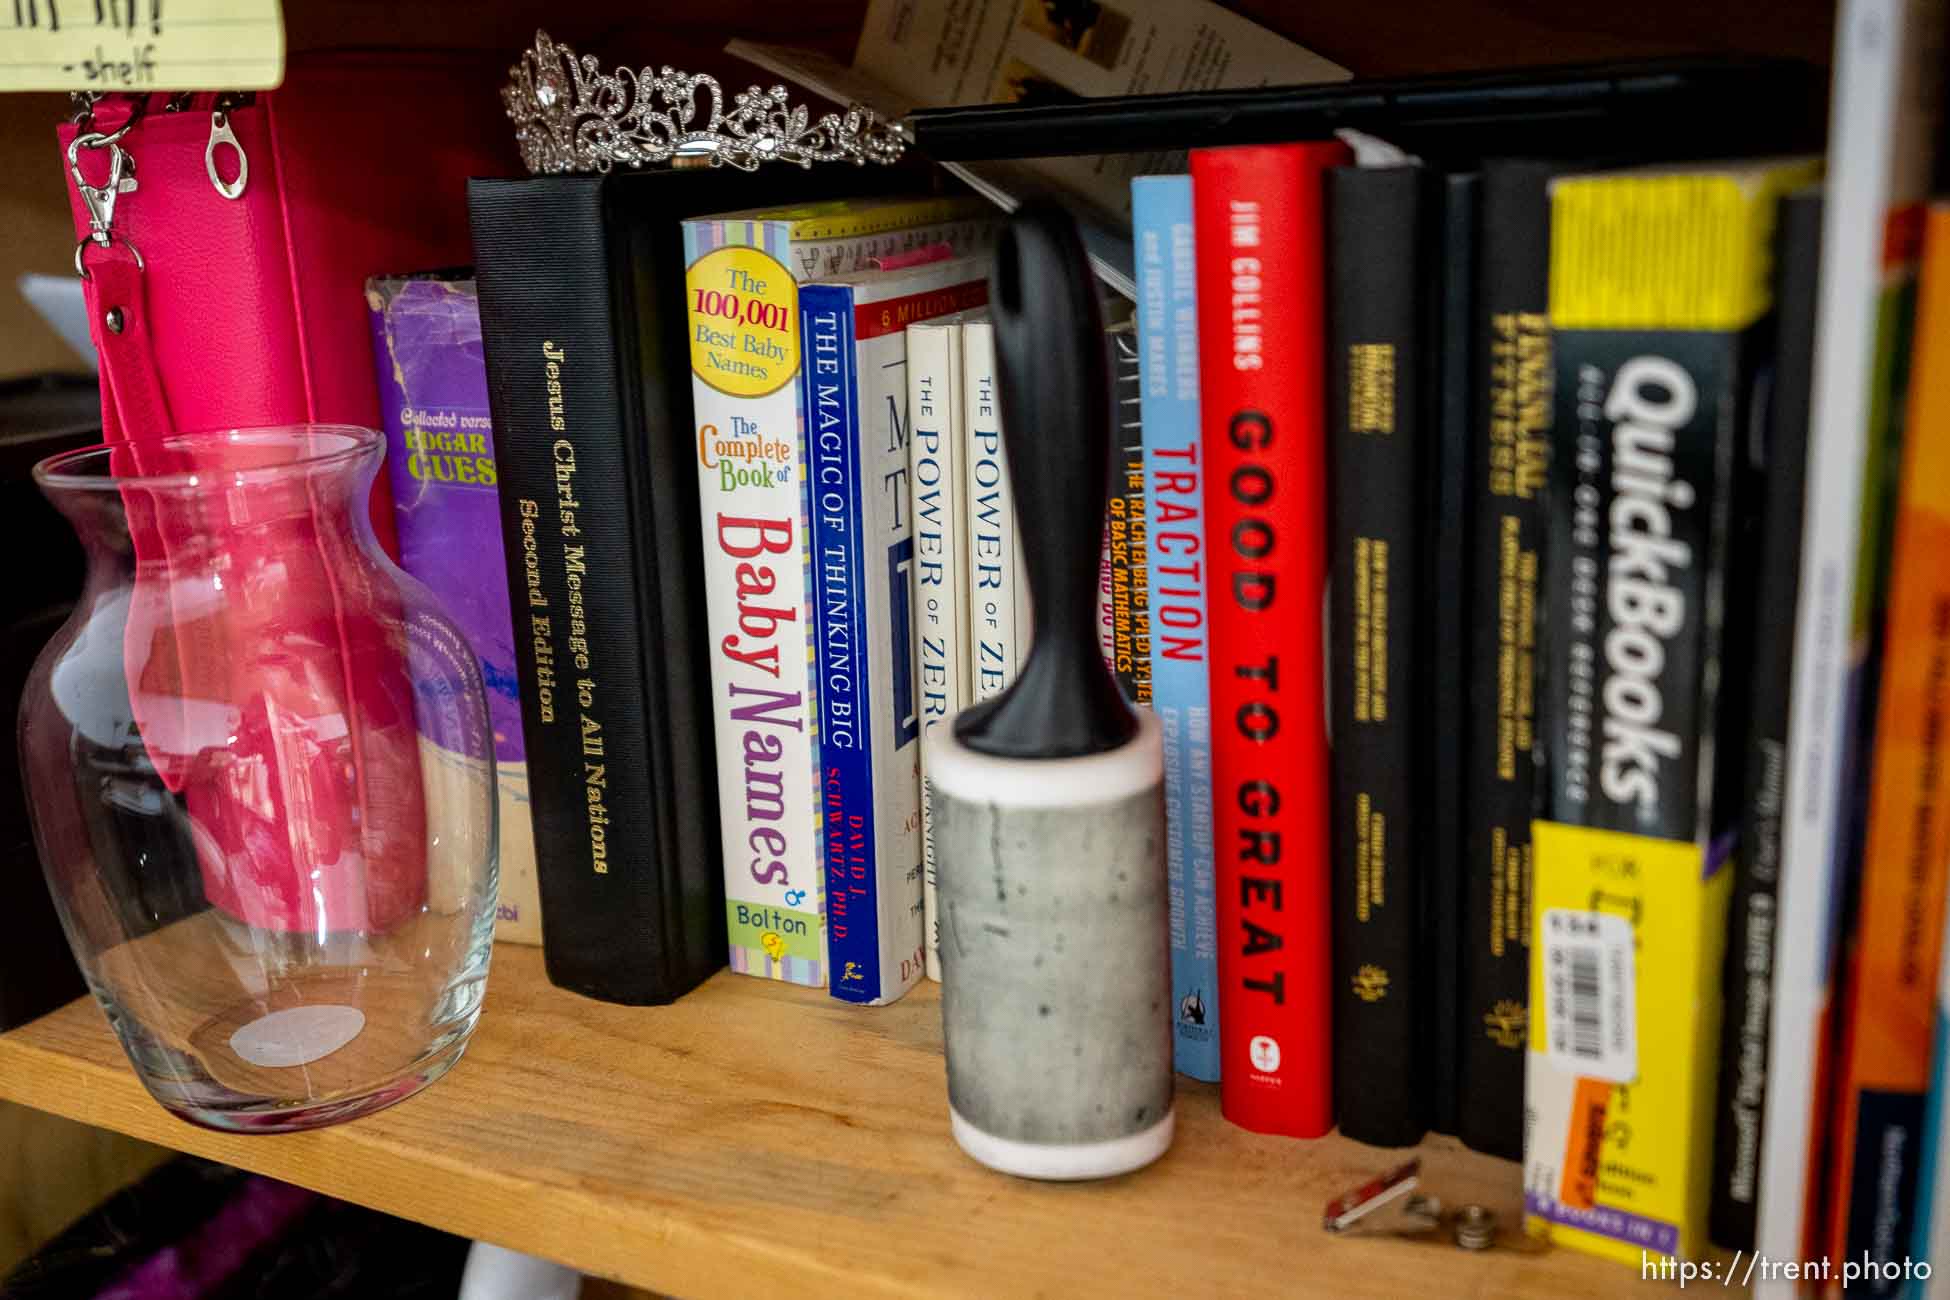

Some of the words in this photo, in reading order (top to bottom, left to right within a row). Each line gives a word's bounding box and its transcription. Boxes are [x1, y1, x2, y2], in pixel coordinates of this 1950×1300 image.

[1229, 199, 1262, 248] JIM
[725, 267, 768, 296] The
[692, 288, 790, 333] 100,001
[881, 310, 891, 327] 6
[1231, 257, 1264, 372] COLLINS
[695, 323, 737, 350] Best
[743, 333, 790, 367] Baby
[706, 350, 769, 381] Names
[814, 311, 839, 375] THE
[542, 340, 566, 431] Jesus
[919, 375, 933, 417] THE
[978, 375, 993, 417] THE
[404, 431, 488, 454] EDGAR
[699, 424, 791, 469] Complete
[730, 415, 759, 438] The
[817, 383, 844, 486] MAGIC
[407, 453, 498, 486] GUES
[553, 439, 581, 537] Christ
[718, 458, 775, 492] Book
[776, 464, 792, 483] of
[822, 492, 845, 532] OF
[916, 429, 944, 586] POWER
[974, 429, 1002, 590] POWER
[1109, 497, 1125, 520] OF
[1228, 410, 1277, 612] GOOD
[519, 498, 549, 609] Second
[1111, 520, 1128, 566] BASIC
[1152, 441, 1204, 662] TRACTION
[563, 543, 590, 671] Message
[717, 512, 797, 679] Baby
[926, 598, 939, 625] OF
[983, 601, 998, 629] OF
[1600, 355, 1700, 824] QuickBooks
[824, 544, 851, 693] THINKING
[1113, 567, 1133, 674] MATHEMATICS
[531, 614, 556, 724] Edition
[576, 677, 597, 708] to
[979, 639, 1005, 694] ZE
[830, 699, 854, 749] BIG
[1233, 655, 1281, 743] TO
[580, 713, 605, 757] All
[728, 682, 804, 886] Names
[584, 762, 609, 874] Nations
[1190, 782, 1212, 850] STARTUP
[848, 814, 866, 874] DAVID
[1236, 778, 1287, 1006] GREAT
[736, 904, 808, 936] Bolton
